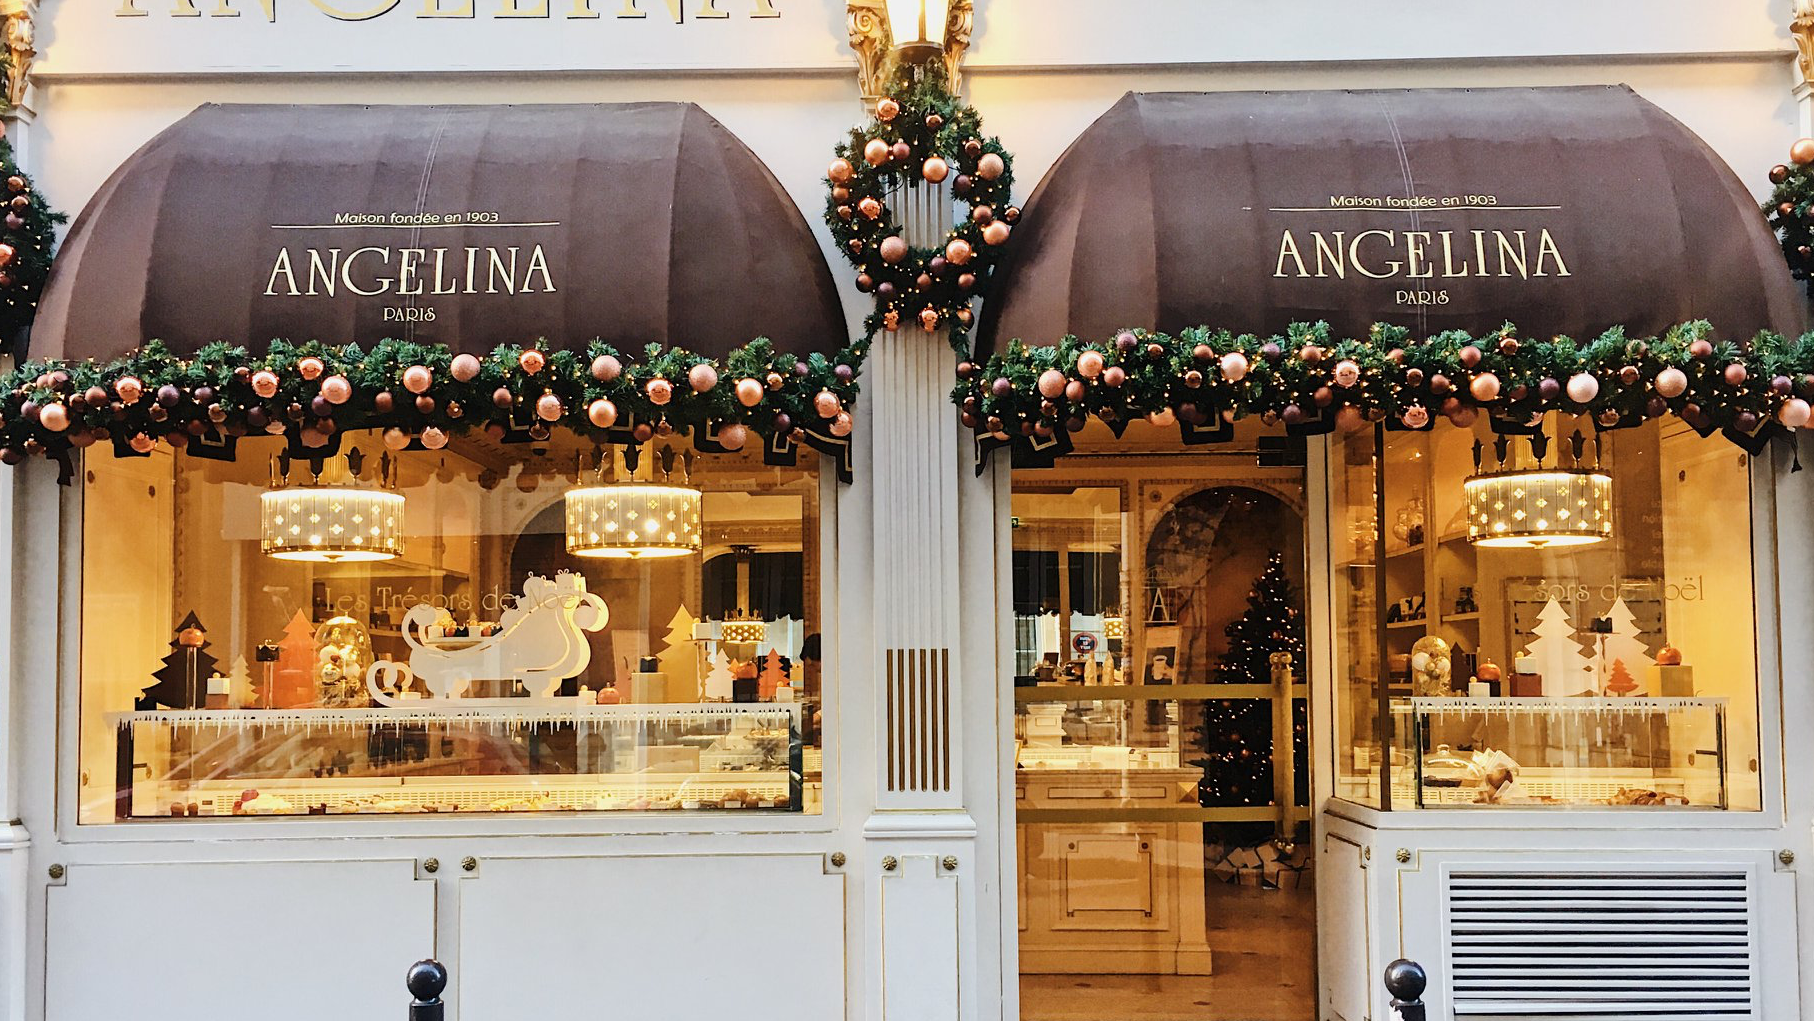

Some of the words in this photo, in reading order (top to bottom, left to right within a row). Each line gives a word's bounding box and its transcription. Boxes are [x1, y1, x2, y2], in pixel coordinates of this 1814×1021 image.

[1329, 194, 1382, 207] Maison
[1386, 194, 1437, 207] fondée
[1441, 196, 1460, 206] en
[1463, 194, 1498, 206] 1903
[334, 212, 386, 224] Maison
[390, 211, 441, 224] fondée
[444, 213, 462, 223] en
[466, 211, 499, 223] 1903
[1272, 228, 1572, 281] ANGELINA
[263, 243, 558, 298] ANGELINA
[1396, 289, 1450, 305] PARIS
[383, 306, 436, 322] PARIS
[324, 587, 368, 612] Les
[376, 585, 472, 611] Trésors
[481, 583, 519, 611] de
